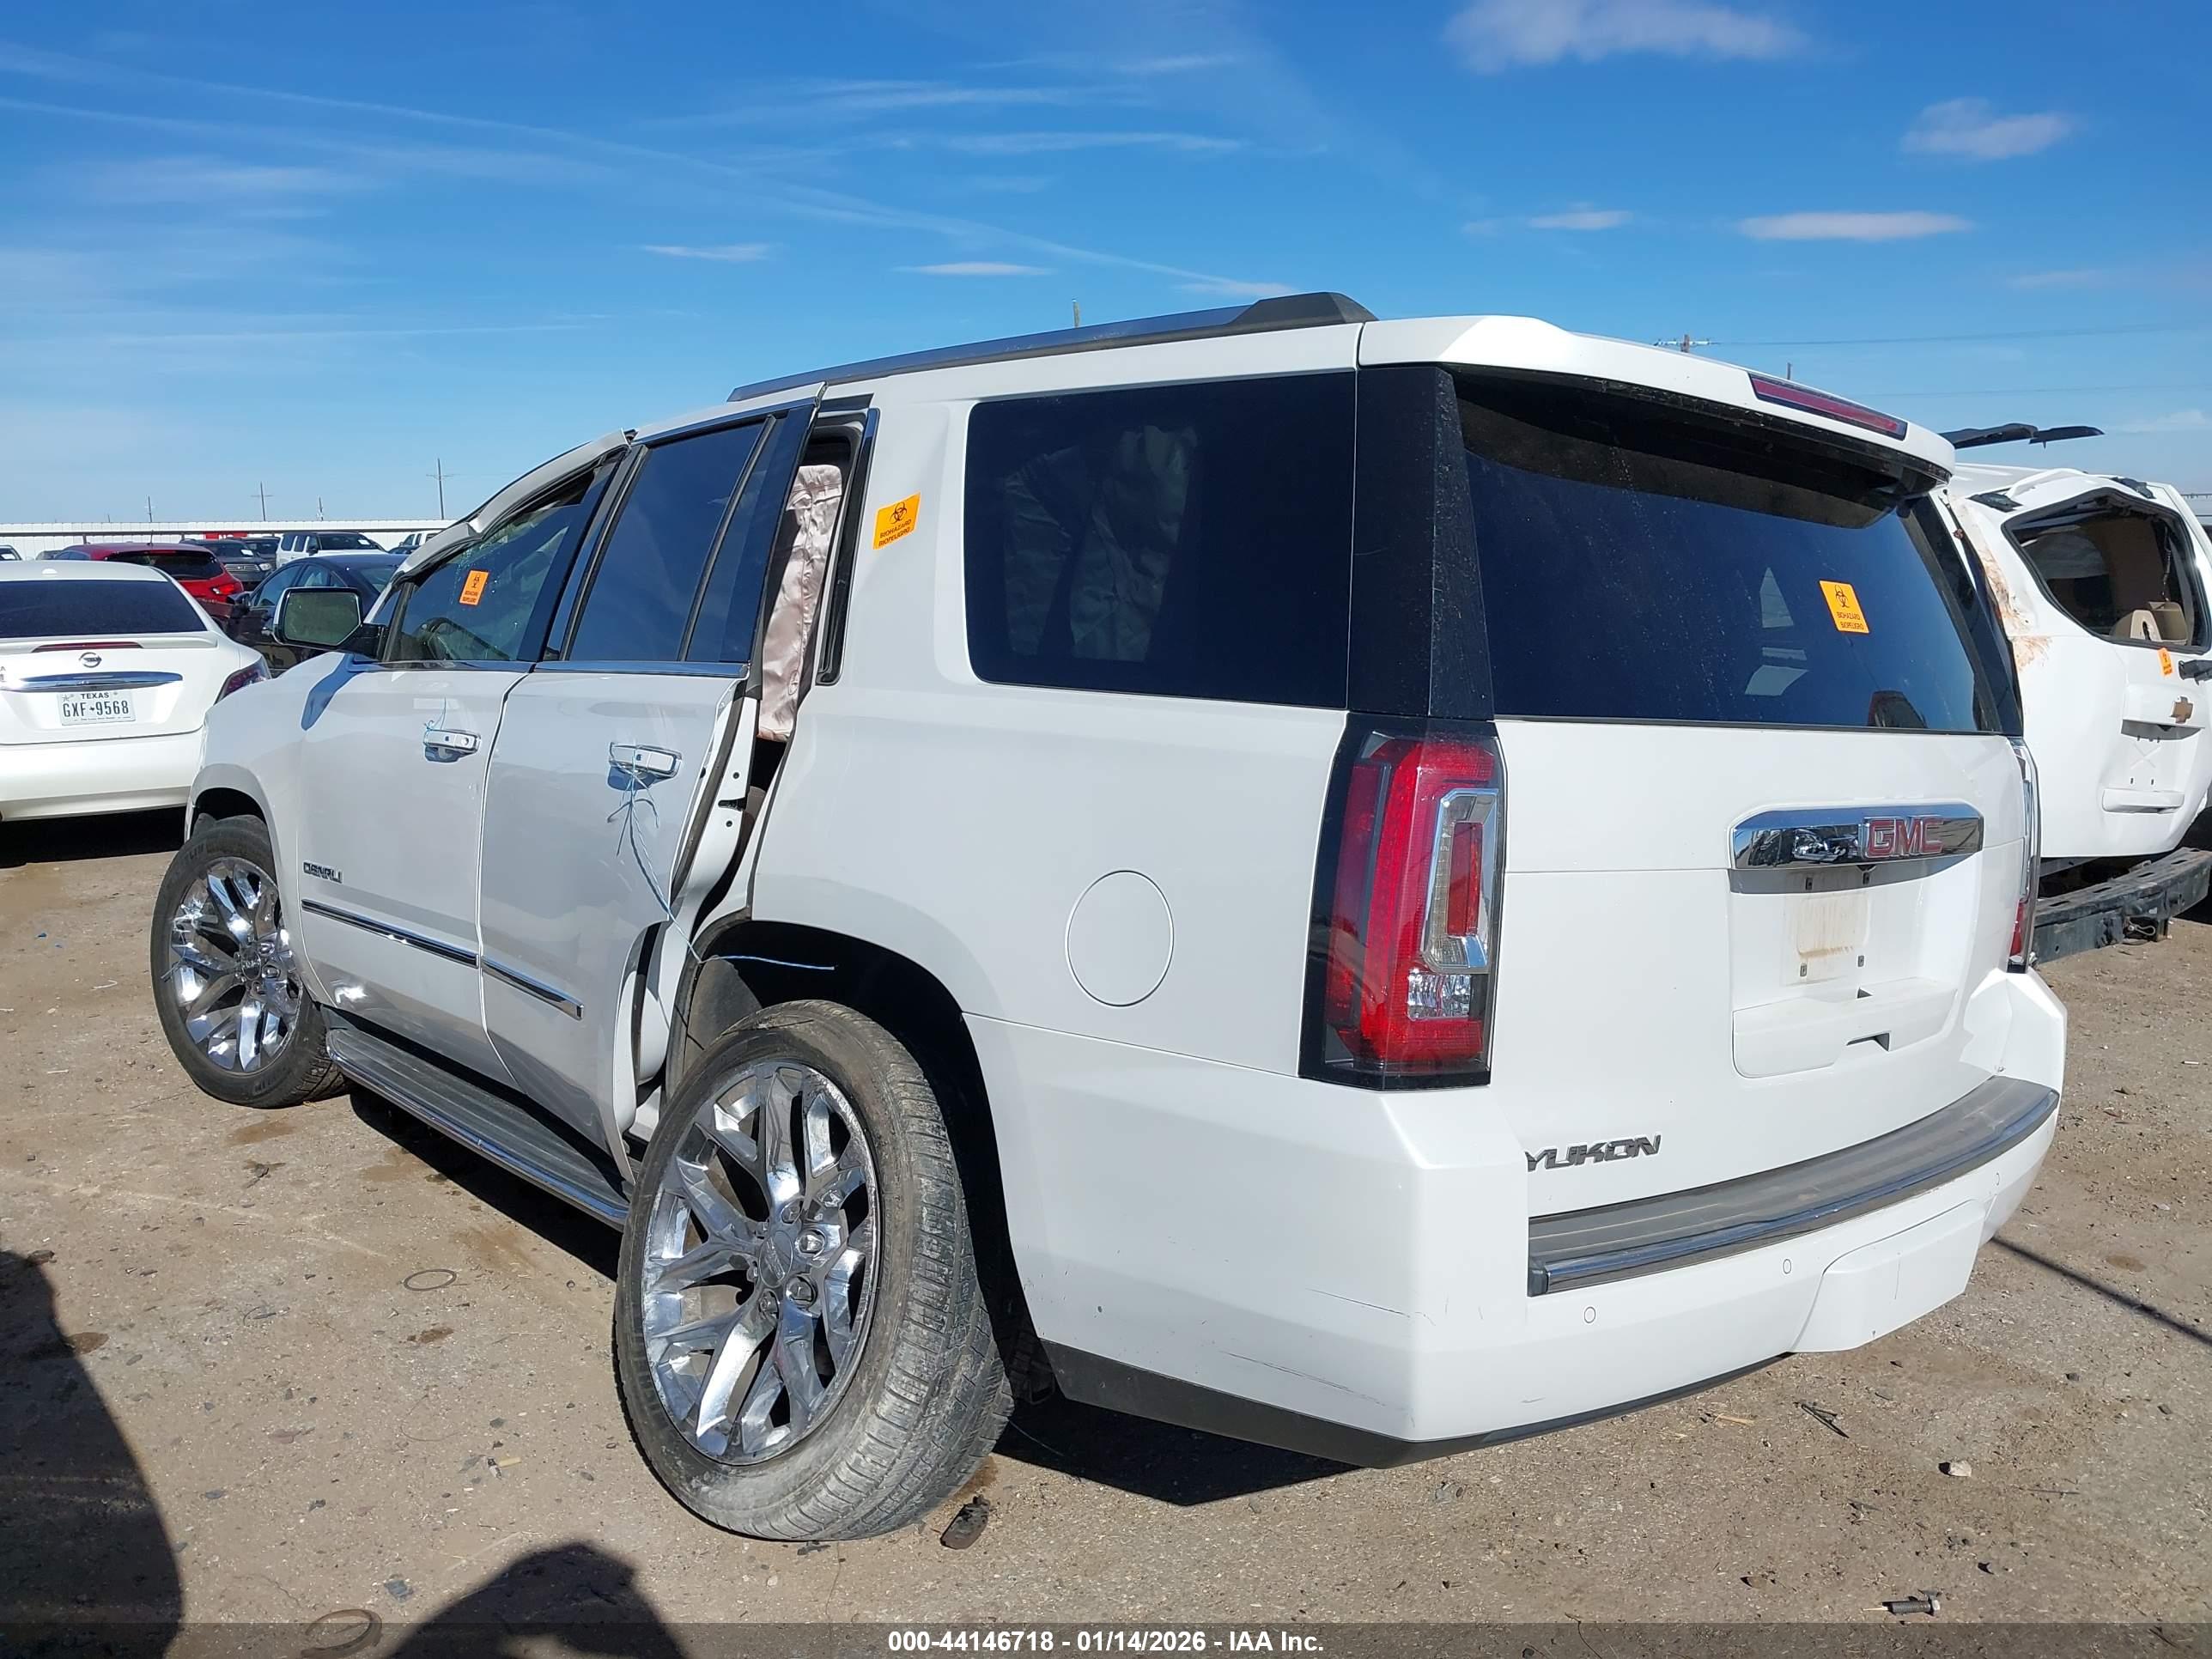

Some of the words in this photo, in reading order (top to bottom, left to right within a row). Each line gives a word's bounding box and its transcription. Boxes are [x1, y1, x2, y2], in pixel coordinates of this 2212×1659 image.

[1864, 815, 1946, 859] GMC
[303, 861, 343, 884] DENALI
[1524, 1133, 1662, 1172] YUKON
